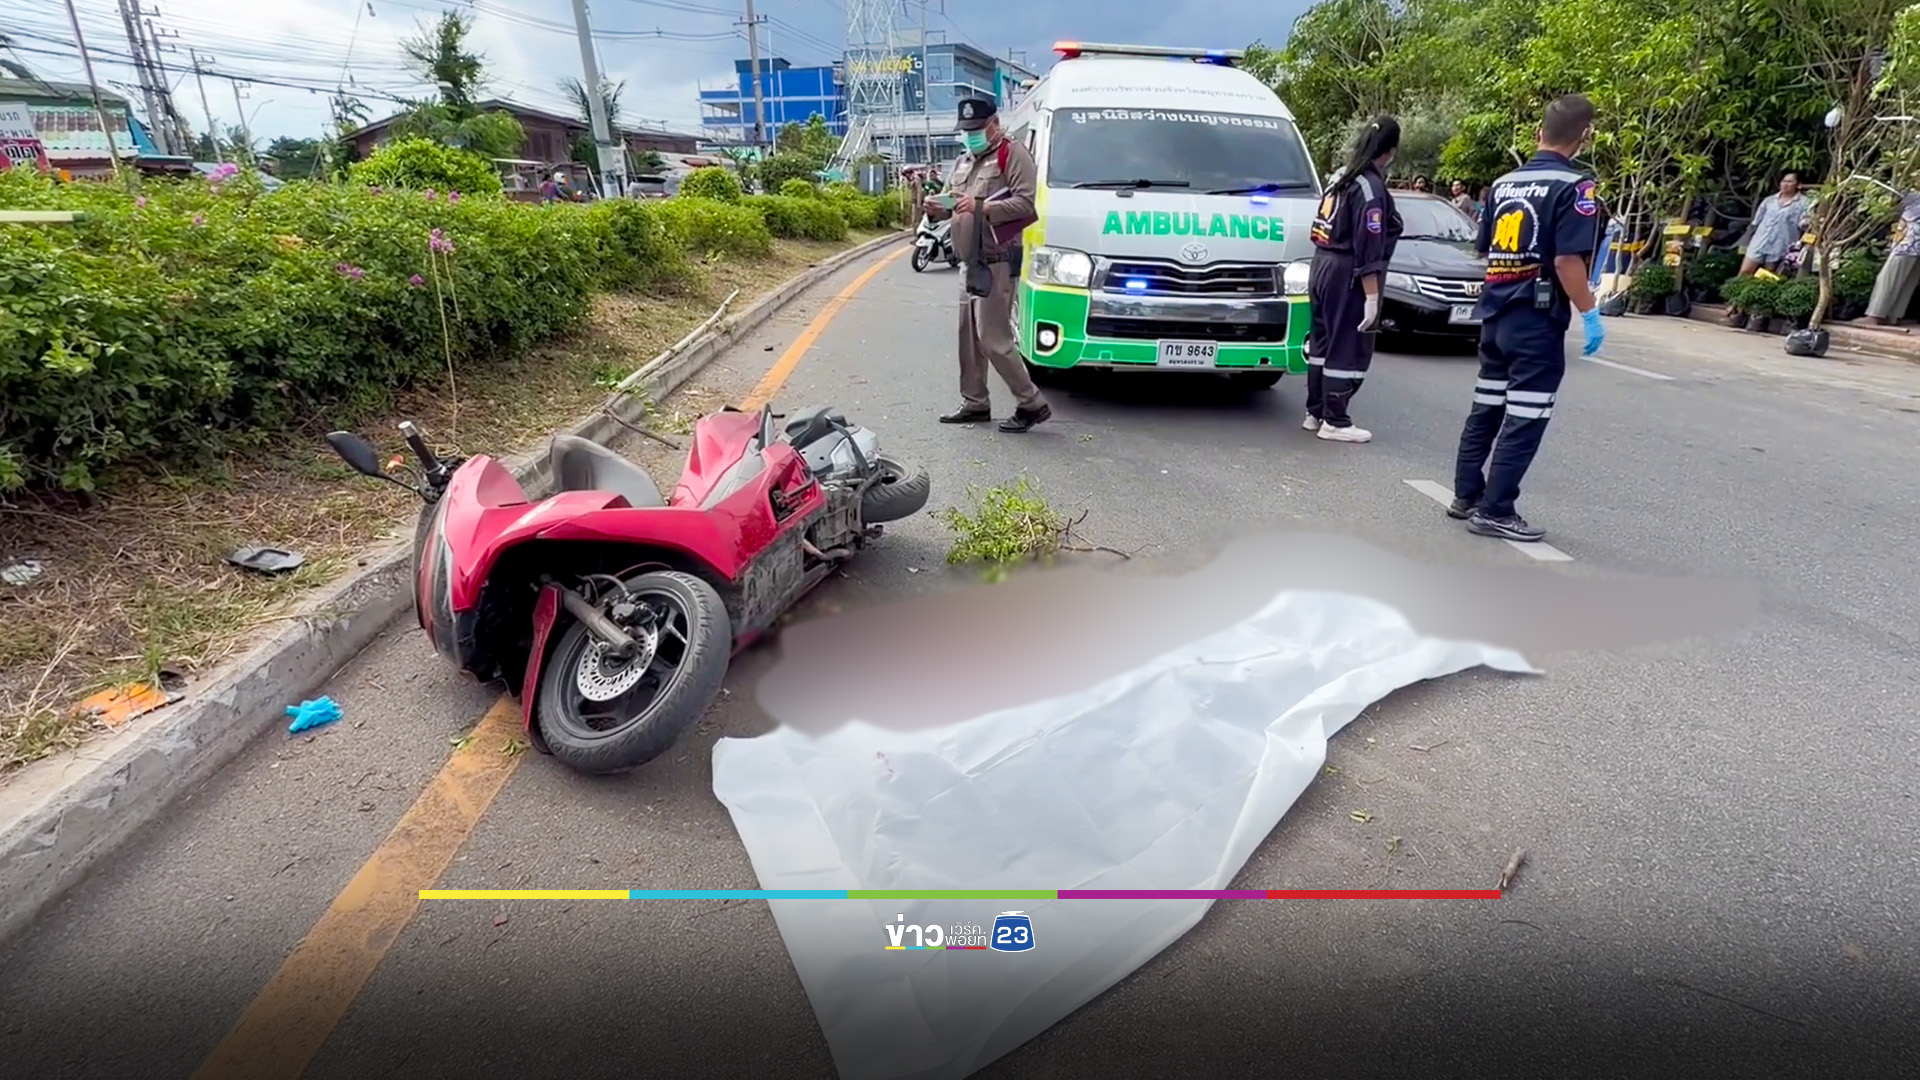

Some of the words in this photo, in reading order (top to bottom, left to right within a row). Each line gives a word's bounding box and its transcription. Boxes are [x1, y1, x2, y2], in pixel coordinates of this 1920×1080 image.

[1071, 109, 1278, 130] มูลนิธิสว่างเบญจธรรม
[1102, 210, 1285, 242] AMBULANCE
[1187, 345, 1215, 357] 9643
